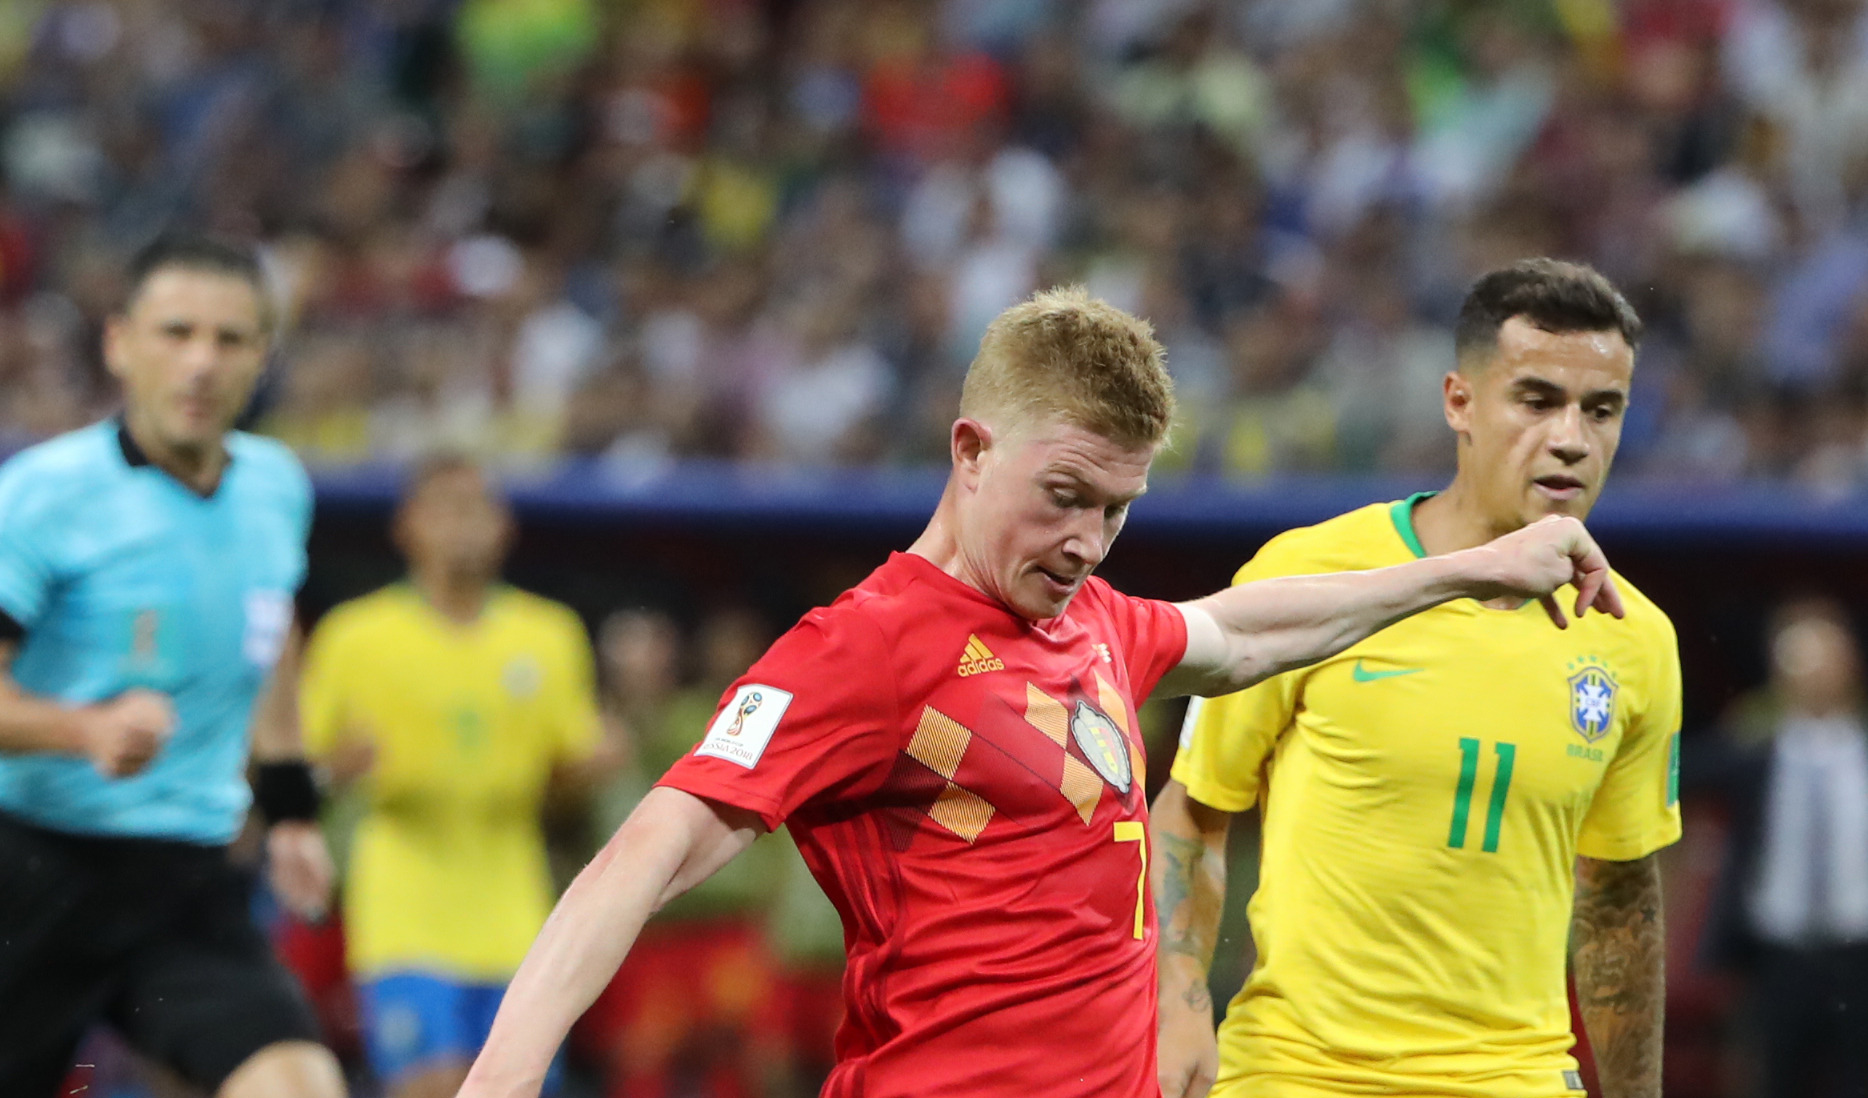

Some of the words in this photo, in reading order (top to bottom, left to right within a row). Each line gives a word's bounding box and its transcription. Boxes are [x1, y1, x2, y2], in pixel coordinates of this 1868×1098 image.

[957, 657, 1005, 677] adidas
[730, 747, 753, 760] 2018
[1447, 736, 1516, 853] 11
[1113, 821, 1147, 940] 7
